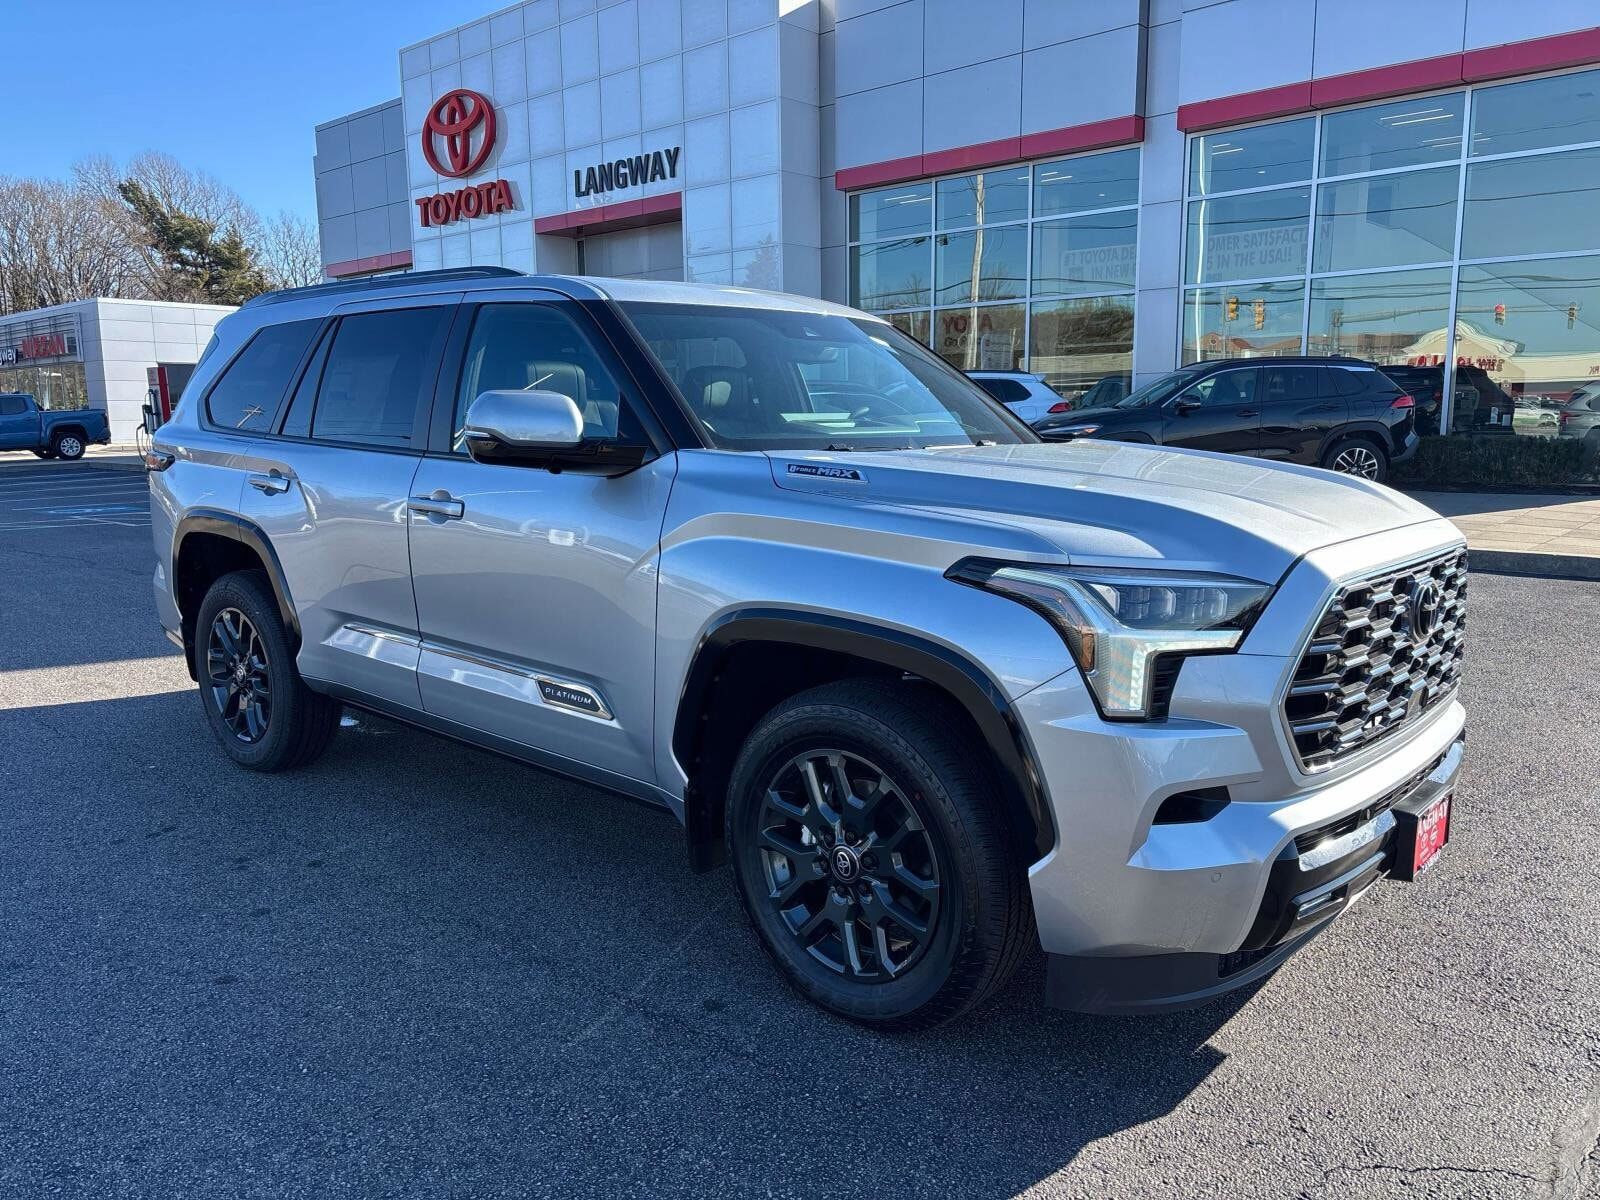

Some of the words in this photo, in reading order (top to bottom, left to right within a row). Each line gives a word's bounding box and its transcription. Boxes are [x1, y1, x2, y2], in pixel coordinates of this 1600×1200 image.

[574, 147, 680, 198] LANGWAY
[416, 179, 513, 227] TOYOTA
[1080, 247, 1119, 264] TOYOTA
[1217, 254, 1230, 270] IN
[1234, 252, 1256, 267] THE
[817, 467, 854, 478] MAX
[545, 687, 592, 705] PLATINUM
